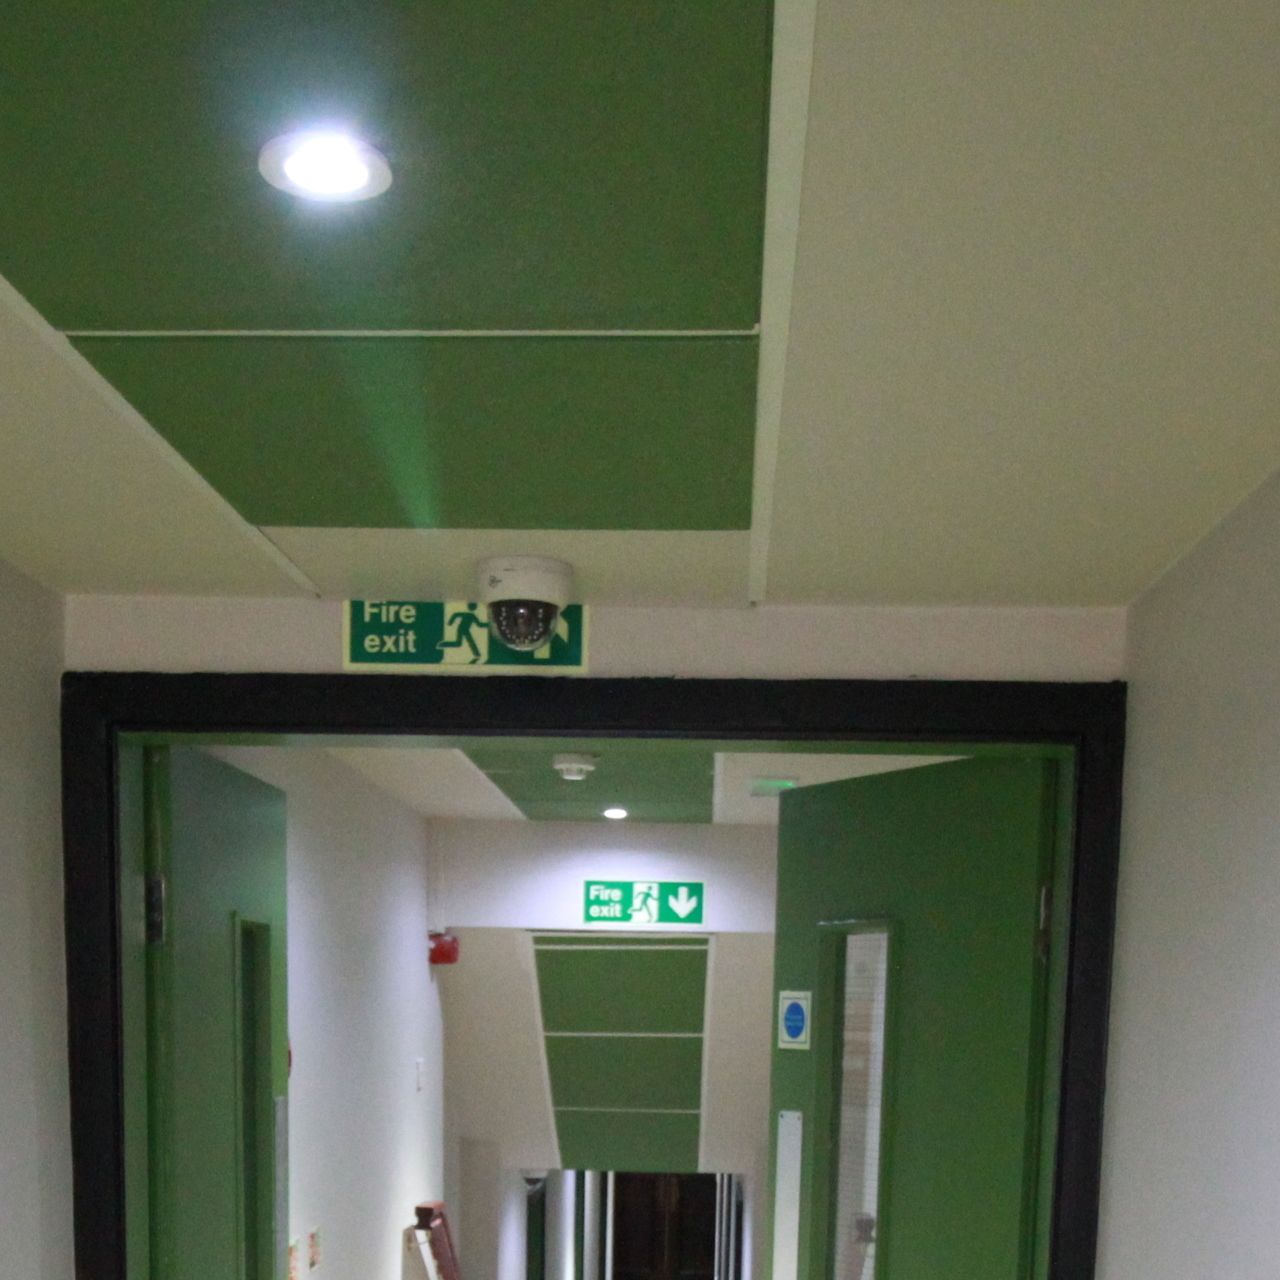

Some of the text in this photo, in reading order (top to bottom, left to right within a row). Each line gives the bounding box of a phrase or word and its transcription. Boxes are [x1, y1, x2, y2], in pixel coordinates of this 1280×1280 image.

[363, 601, 416, 624] Fire
[363, 629, 417, 653] exit
[589, 884, 622, 901] Fire
[589, 902, 622, 918] exit
